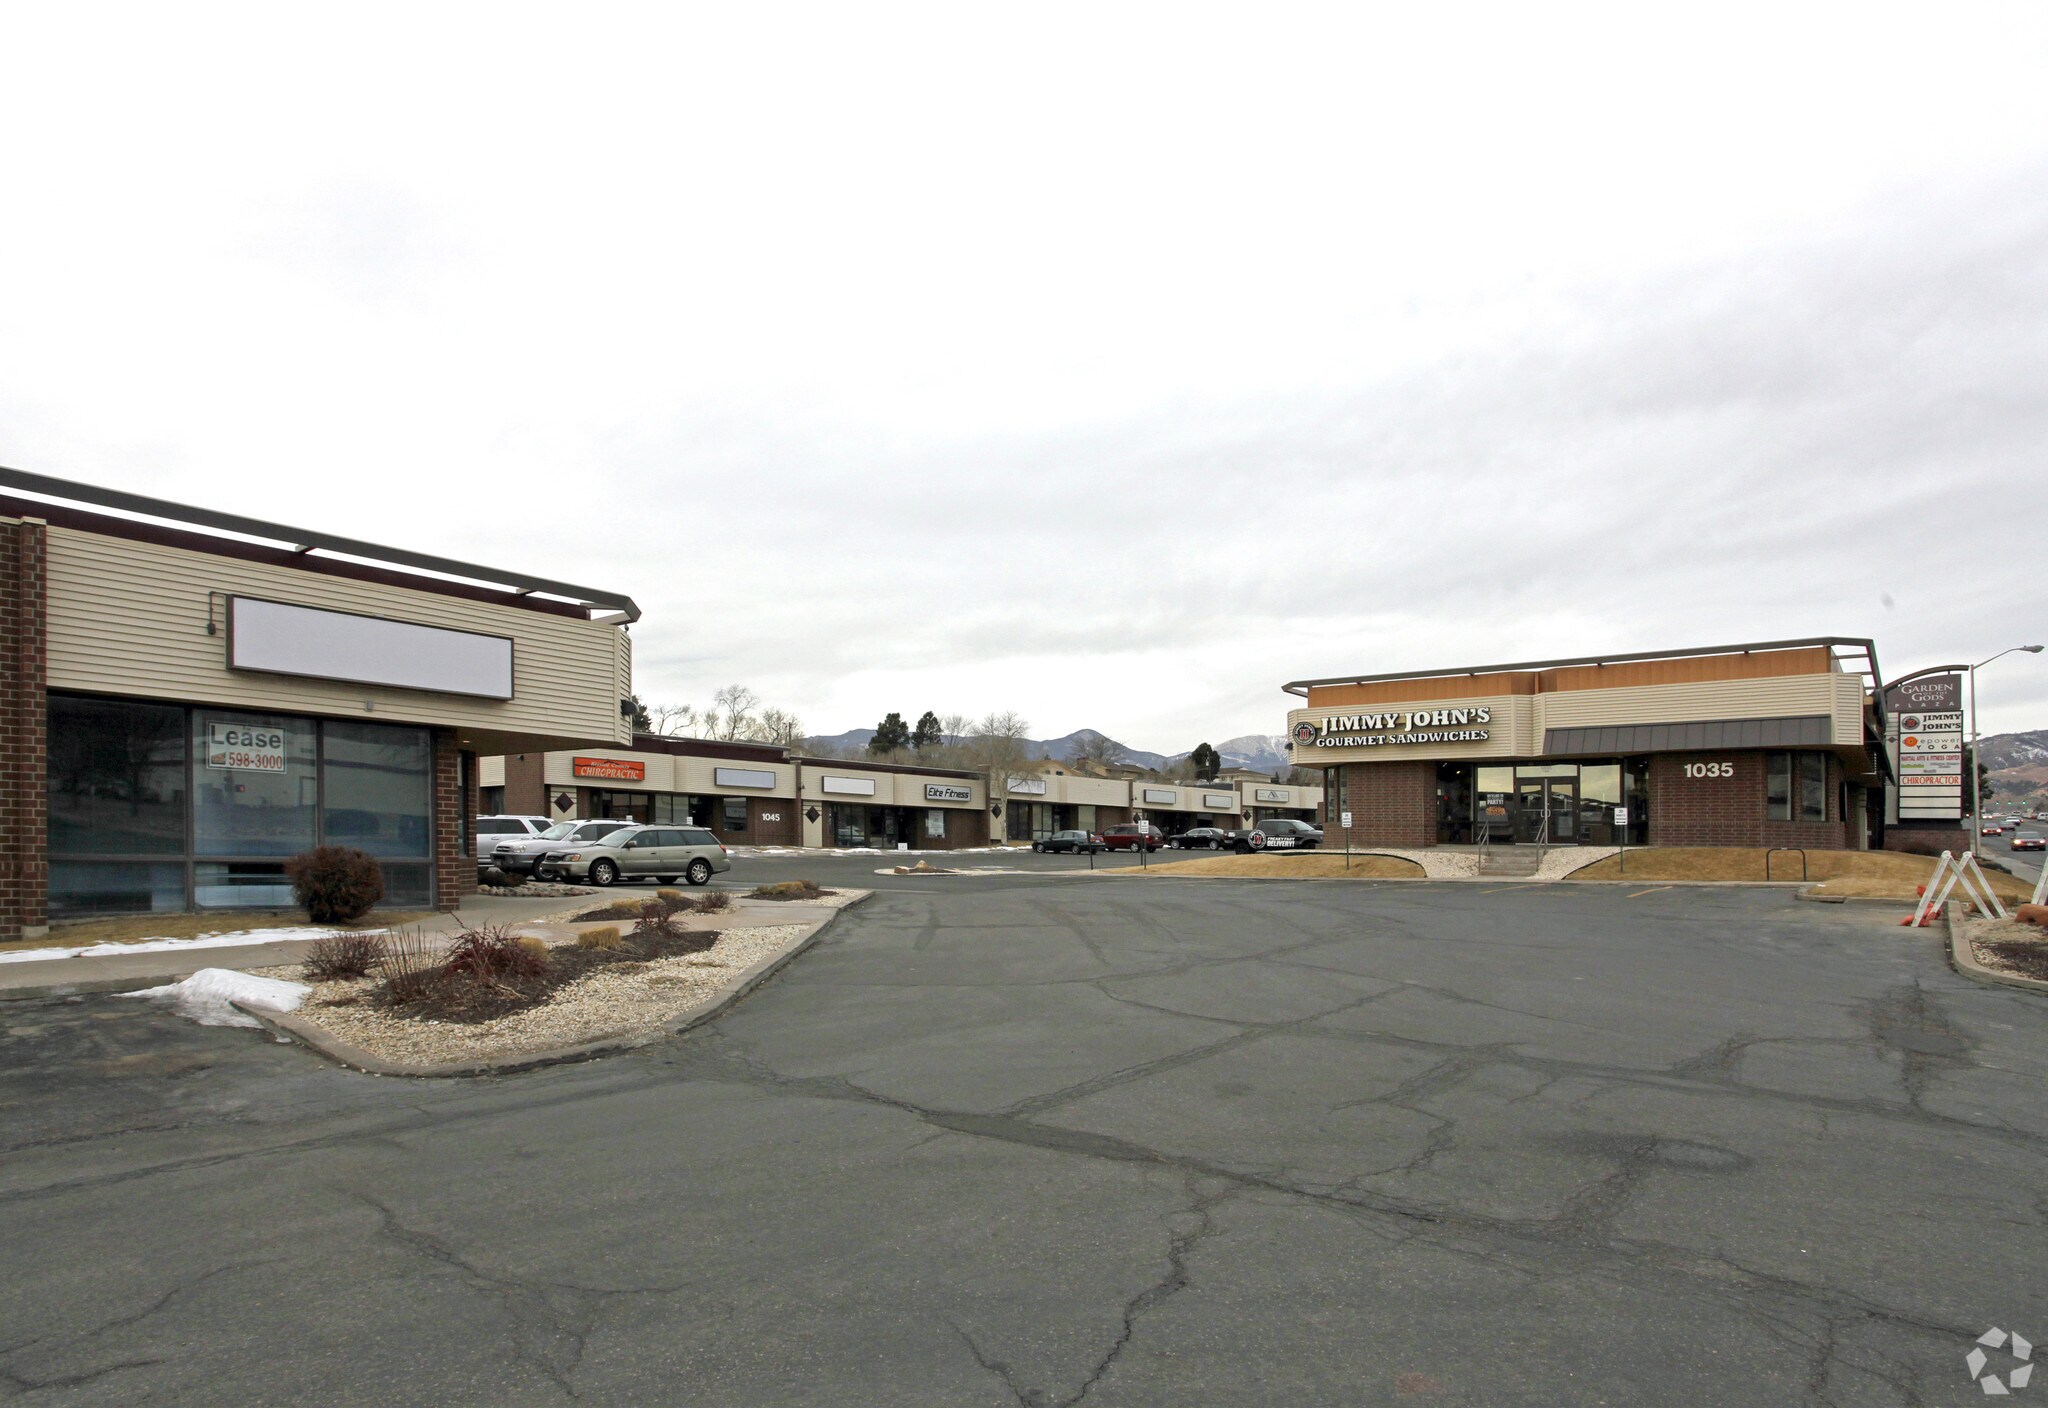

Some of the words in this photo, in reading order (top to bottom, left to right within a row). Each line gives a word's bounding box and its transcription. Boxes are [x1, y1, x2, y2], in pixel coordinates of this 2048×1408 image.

[1901, 683, 1953, 695] GARDEN
[1911, 692, 1944, 702] GODS
[1321, 712, 1400, 736] JIMMY
[1404, 707, 1491, 732] JOHN'S
[1922, 714, 1962, 722] JIMMY
[1922, 723, 1962, 731] JOHN'S
[211, 725, 281, 749] Lease
[1315, 734, 1386, 748] GOURMET
[1388, 729, 1490, 745] SANDWICHES
[228, 752, 283, 770] 598-3000
[580, 766, 640, 780] CHIROPRACTIC
[1684, 762, 1734, 778] 1035
[1902, 776, 1959, 785] CHIROPRACTOR
[928, 787, 943, 797] Elite
[944, 788, 970, 799] Fitness
[762, 813, 780, 822] 1045
